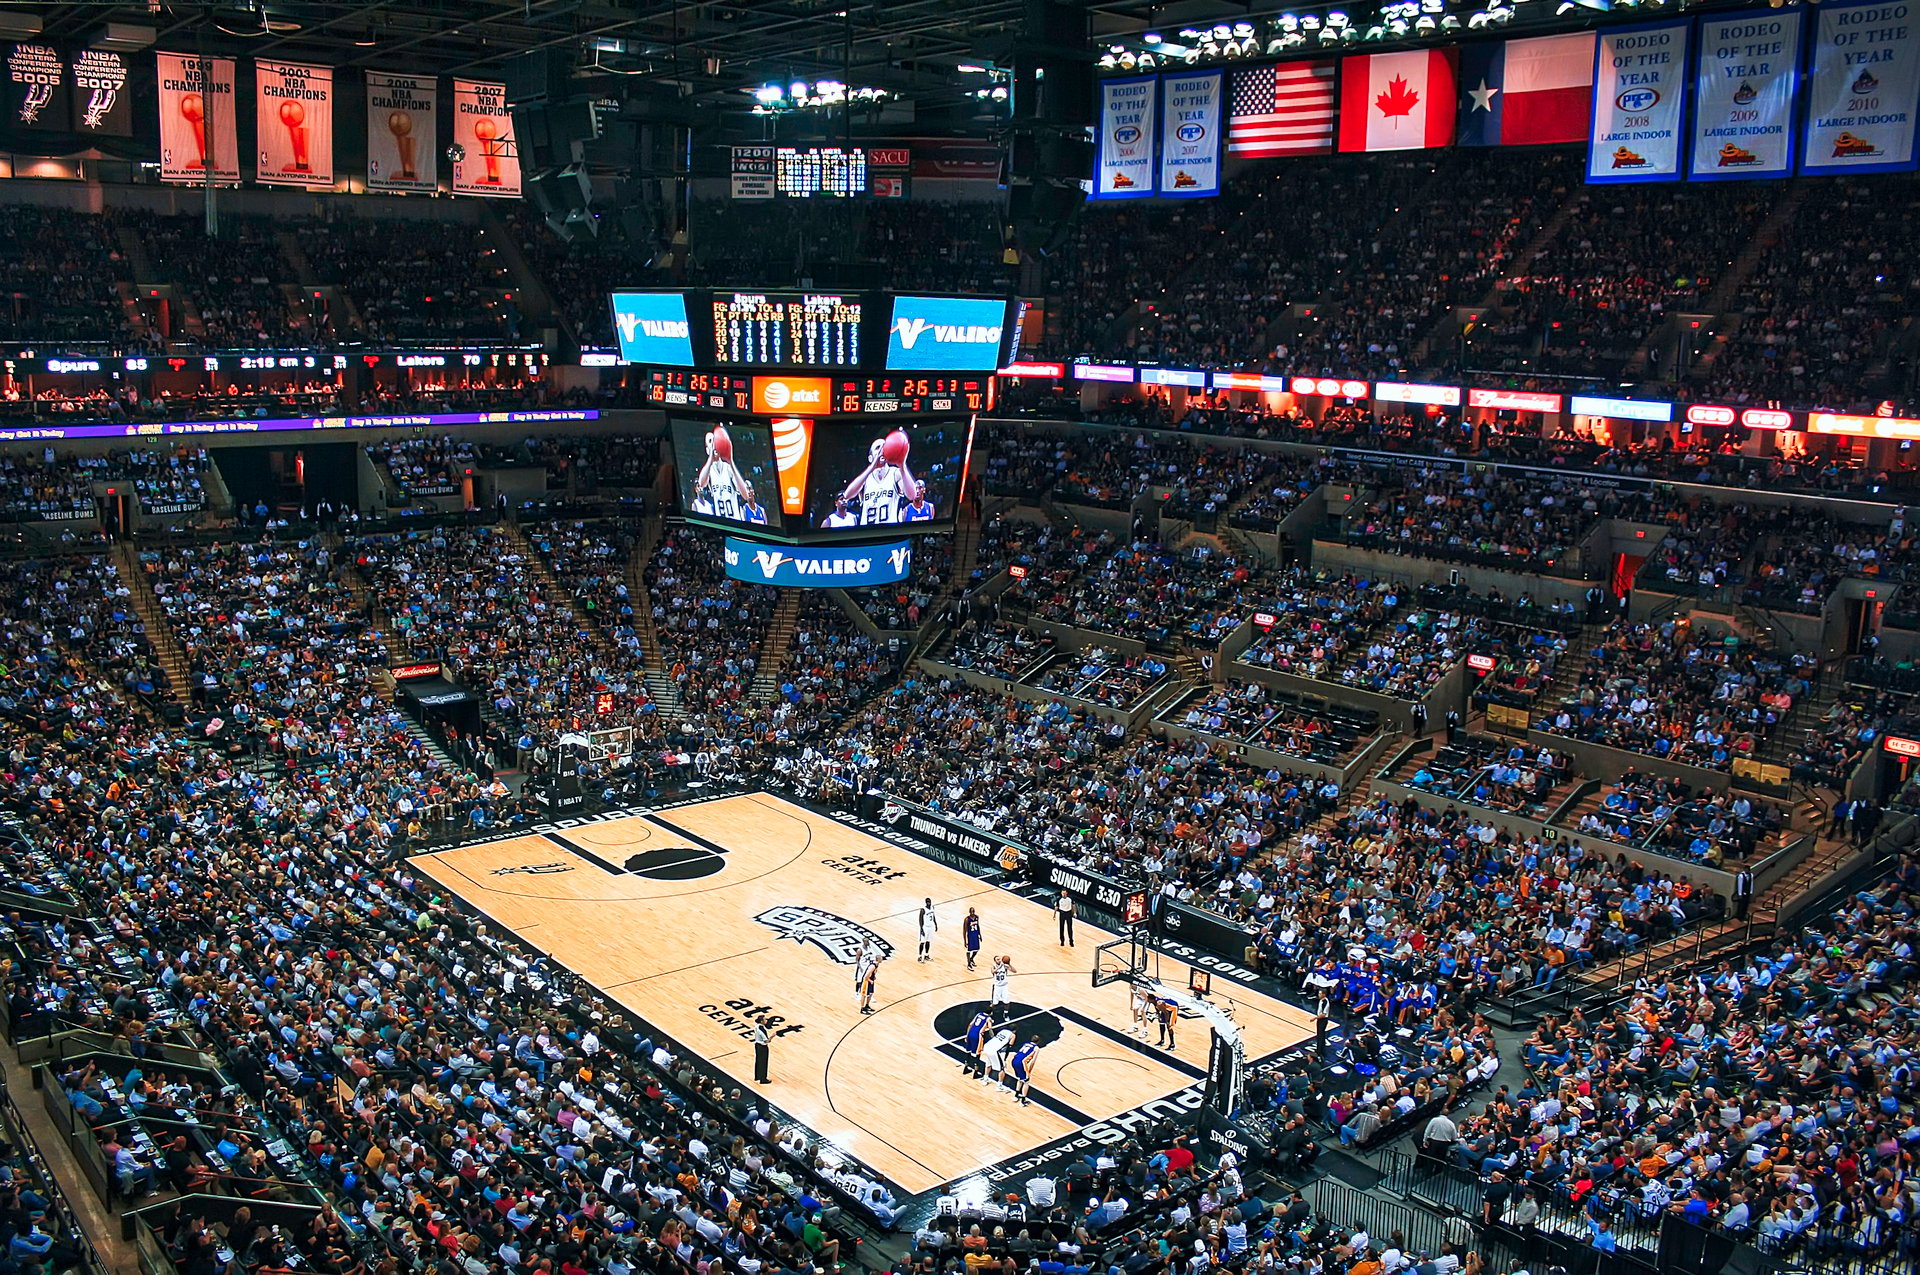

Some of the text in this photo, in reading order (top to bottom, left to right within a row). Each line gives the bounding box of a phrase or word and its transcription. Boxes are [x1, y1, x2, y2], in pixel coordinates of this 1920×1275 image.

[1838, 5, 1908, 26] RODEO
[1720, 22, 1781, 40] RODEO
[1834, 26, 1908, 46] OF THE
[1616, 34, 1670, 50] RODEO
[22, 45, 57, 56] NBA
[1716, 42, 1782, 59] OF THE
[8, 58, 64, 68] CONFERENCE
[14, 53, 57, 62] WESTERN
[79, 58, 120, 68] WESTERN
[88, 52, 120, 62] NBA
[1613, 52, 1671, 68] OF THE
[1844, 50, 1894, 65] YEAR
[10, 65, 62, 74] CHAMPIONS
[72, 64, 128, 74] CONFERENCE
[180, 59, 212, 71] 1999
[1725, 63, 1770, 78] YEAR
[12, 72, 60, 85] 2005
[75, 70, 126, 80] CHAMPIONS
[185, 70, 209, 82] NBA
[280, 68, 310, 78] 2003
[1620, 72, 1660, 85] YEAR
[77, 78, 124, 90] 2007
[164, 80, 230, 94] CHAMPIONS
[284, 78, 306, 90] NBA
[388, 79, 416, 88] 2005
[1175, 81, 1210, 92] RODEO
[264, 86, 327, 100] CHAMPIONS
[392, 89, 412, 100] NBA
[474, 86, 502, 96] 2007
[1112, 86, 1146, 96] RODEO
[372, 96, 431, 110] CHAMPIONS
[478, 96, 498, 106] NBA
[1110, 100, 1146, 110] OF THE
[1172, 96, 1210, 106] OF THE
[1848, 98, 1878, 112] 2010
[460, 104, 510, 117] CHAMPION
[1178, 111, 1204, 120] YEAR
[1730, 110, 1758, 122] 2009
[1116, 116, 1140, 125] YEAR
[1624, 116, 1650, 128] 2008
[1818, 113, 1906, 128] LARGE INDOOR
[1601, 130, 1671, 142] LARGE INDOOR
[1704, 126, 1782, 136] LARGE INDOOR
[736, 148, 771, 158] 1200
[870, 151, 908, 164] SACU
[734, 293, 766, 304] Spurs
[804, 294, 842, 306] Lakers
[776, 304, 783, 312] 9
[714, 312, 784, 321] PL PT FL AS RB
[790, 313, 803, 322] PL
[820, 314, 831, 322] FL
[833, 314, 846, 322] AS
[847, 314, 860, 322] RB
[642, 320, 689, 338] VALERO
[934, 325, 1000, 344] VALERO
[48, 359, 148, 373] Spurs 85
[240, 357, 274, 368] 2:15
[304, 356, 314, 368] 3
[397, 354, 480, 366] Lakers 70
[866, 380, 874, 392] 3
[882, 380, 890, 392] 2
[904, 380, 928, 396] 2:15
[937, 380, 944, 392] 5
[950, 380, 958, 392] 3
[735, 392, 745, 408] 70
[844, 396, 860, 412] 85
[913, 398, 920, 411] 3
[966, 393, 980, 409] 70
[74, 510, 94, 518] BUMS
[152, 503, 200, 514] BASELINE BUMS
[866, 504, 890, 522] 20
[794, 558, 870, 574] VALERO
[392, 666, 440, 678] Budweiser
[564, 797, 574, 806] NBA
[416, 843, 454, 854] SAN
[459, 829, 532, 846] ANTONIO
[530, 806, 652, 834] SPURS
[830, 810, 929, 850] spurs.com
[1545, 830, 1556, 838] 10
[910, 816, 946, 840] THUNDER
[958, 834, 990, 857] LAKERS
[821, 858, 882, 886] CENTER
[841, 854, 908, 880] at&t
[1050, 868, 1120, 908] SUNDAY 3:30
[1166, 917, 1181, 927] abc
[805, 908, 890, 950] SAN ANTONIO
[698, 1004, 756, 1043] CENTE
[725, 998, 805, 1038] at&t
[1210, 1129, 1248, 1158] SPALDING
[940, 1205, 952, 1214] 15
